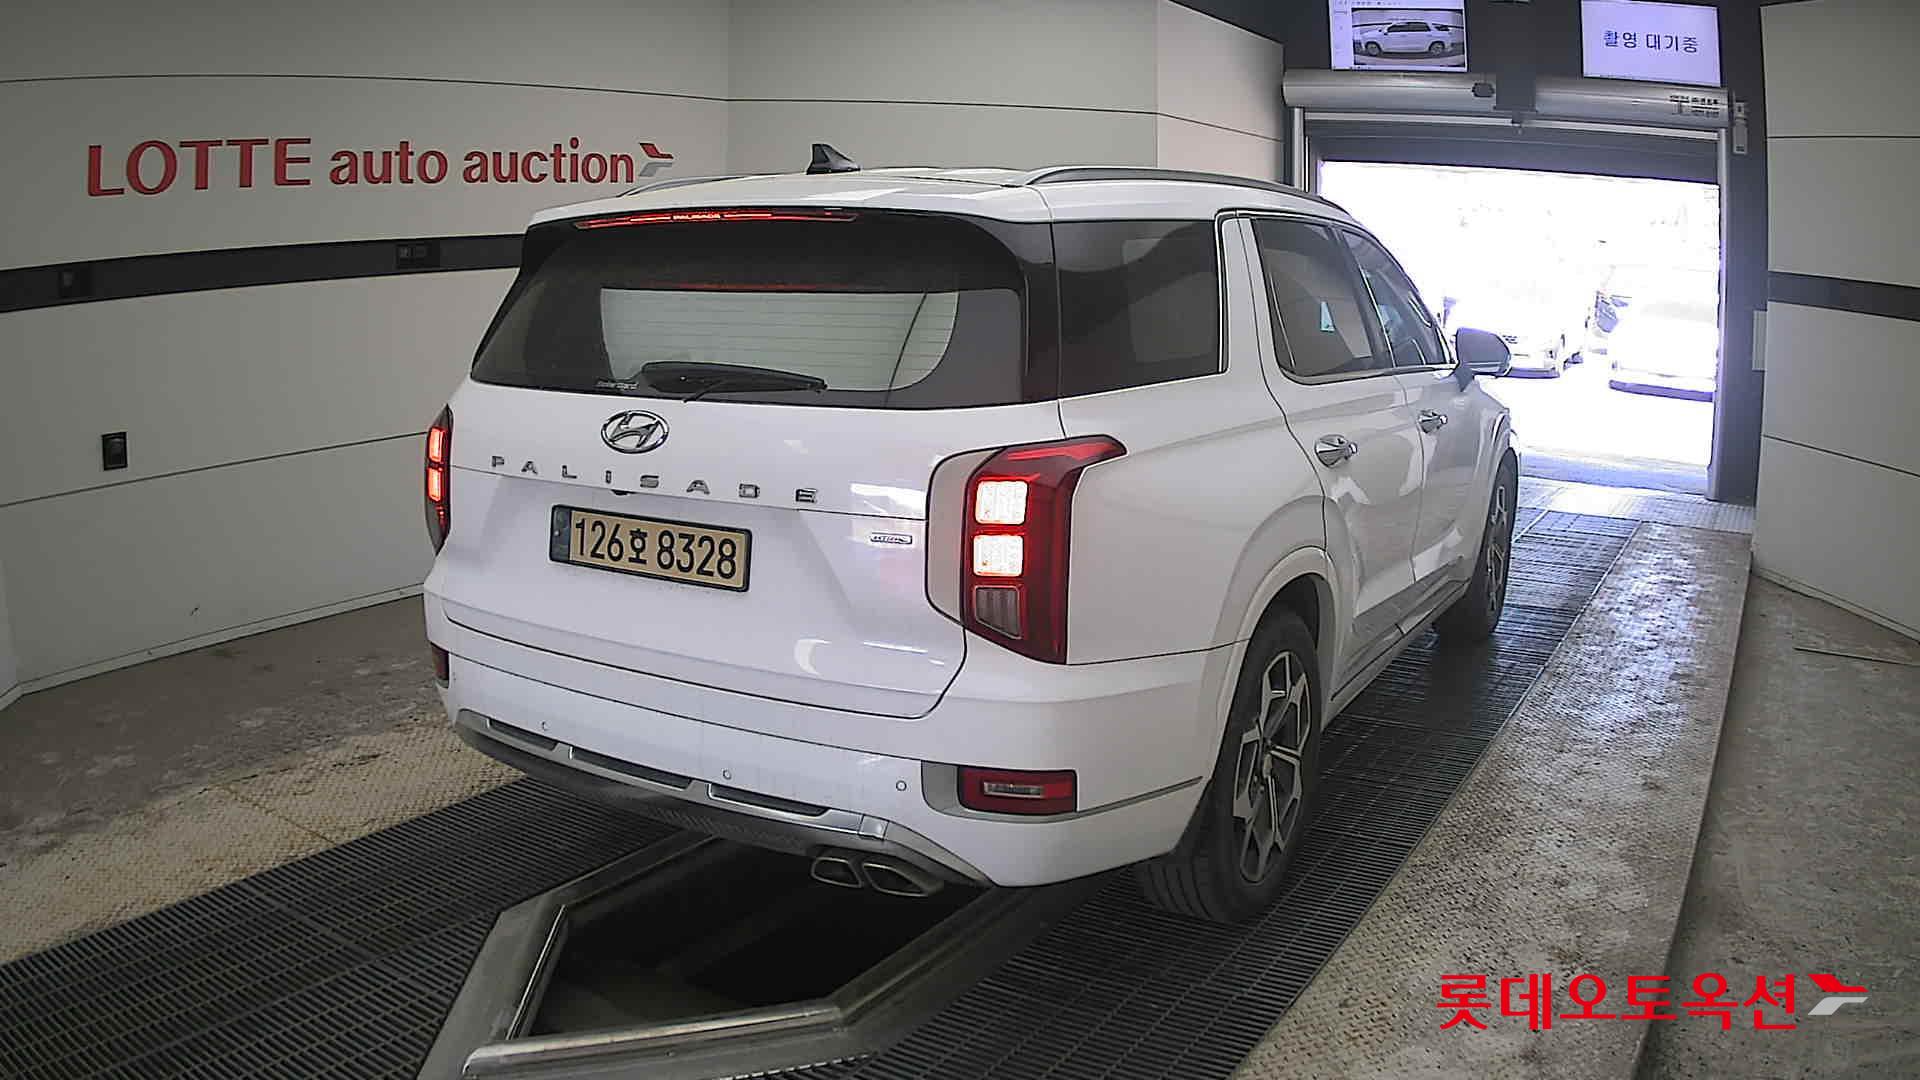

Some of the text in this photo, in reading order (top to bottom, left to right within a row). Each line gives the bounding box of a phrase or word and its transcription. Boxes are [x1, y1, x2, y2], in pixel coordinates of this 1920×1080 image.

[1603, 30, 1698, 54] 촬영 대기중
[87, 137, 636, 197] LOTTE auto auction
[491, 455, 818, 505] PALISADE
[575, 517, 737, 580] 126호 8328
